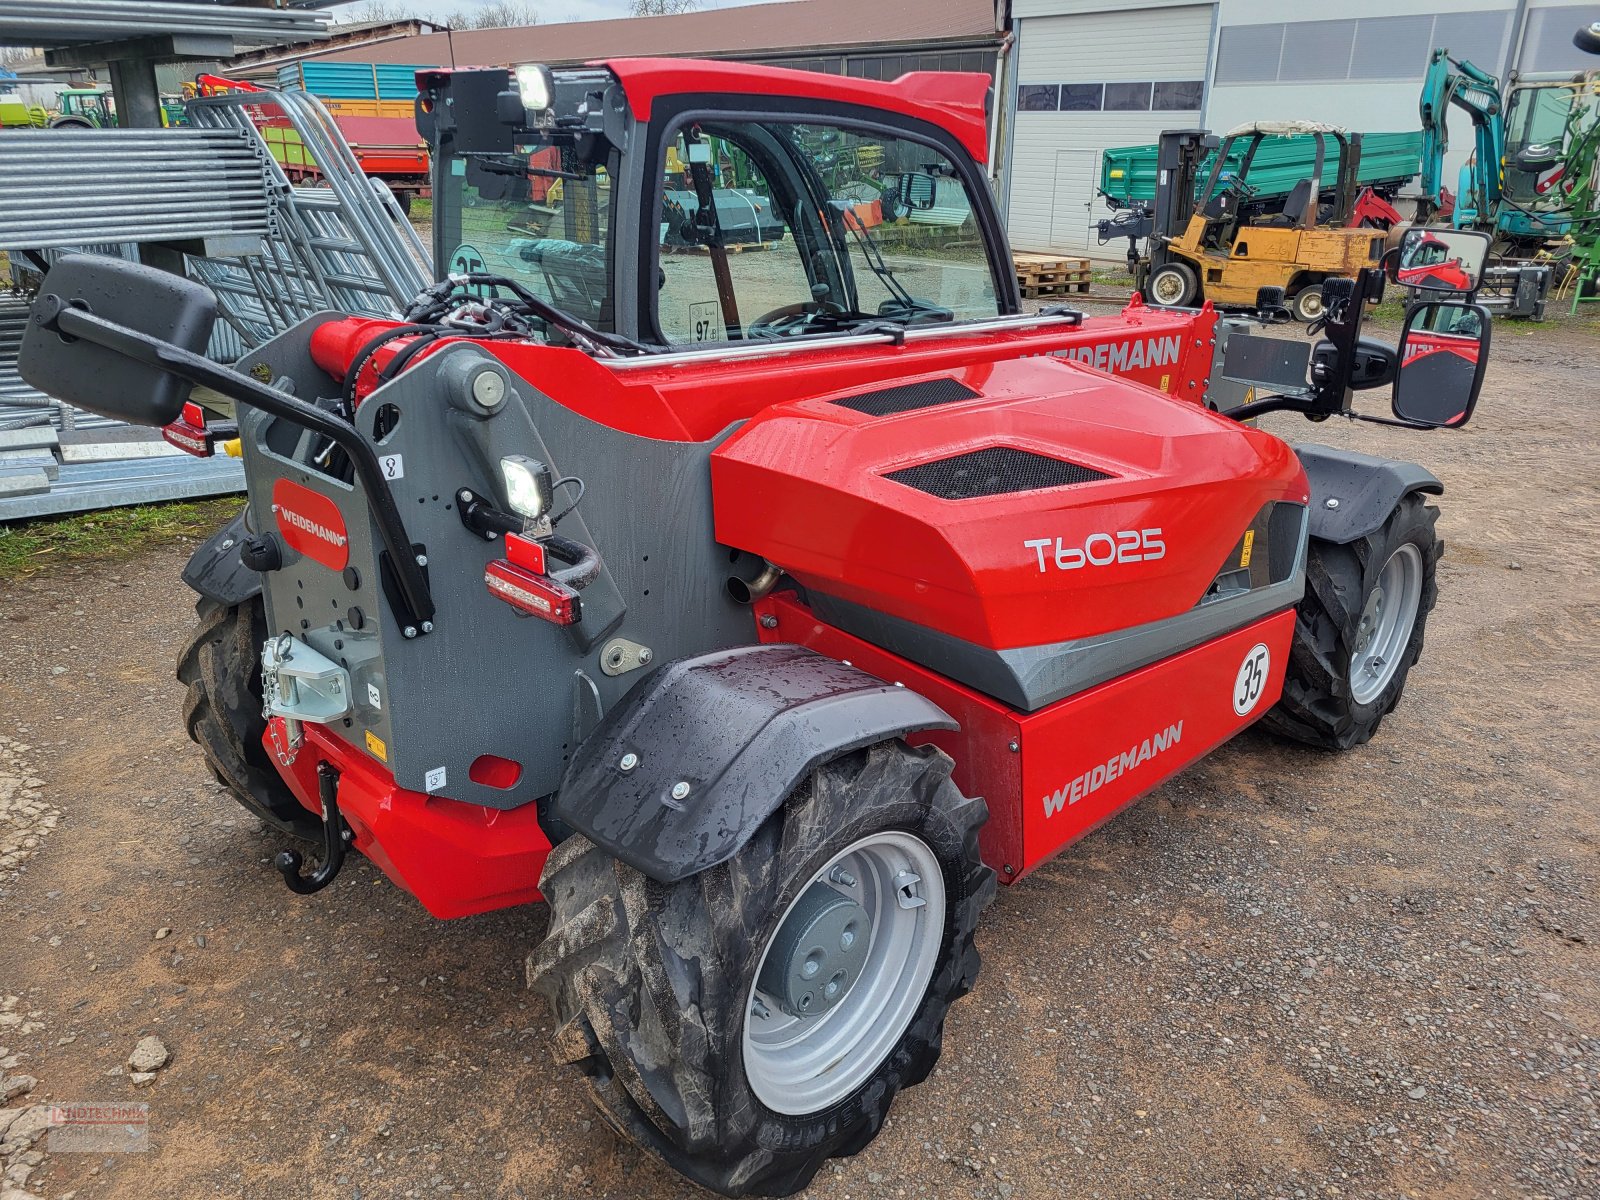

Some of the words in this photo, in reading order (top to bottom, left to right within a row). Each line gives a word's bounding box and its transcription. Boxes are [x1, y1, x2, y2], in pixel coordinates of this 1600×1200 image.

[696, 320, 710, 341] 97
[1020, 335, 1182, 374] DEMANN
[281, 506, 344, 547] WEIDEMANN
[1023, 527, 1166, 573] T6025
[1239, 652, 1266, 707] 35
[1042, 719, 1184, 819] WEIDEMANN
